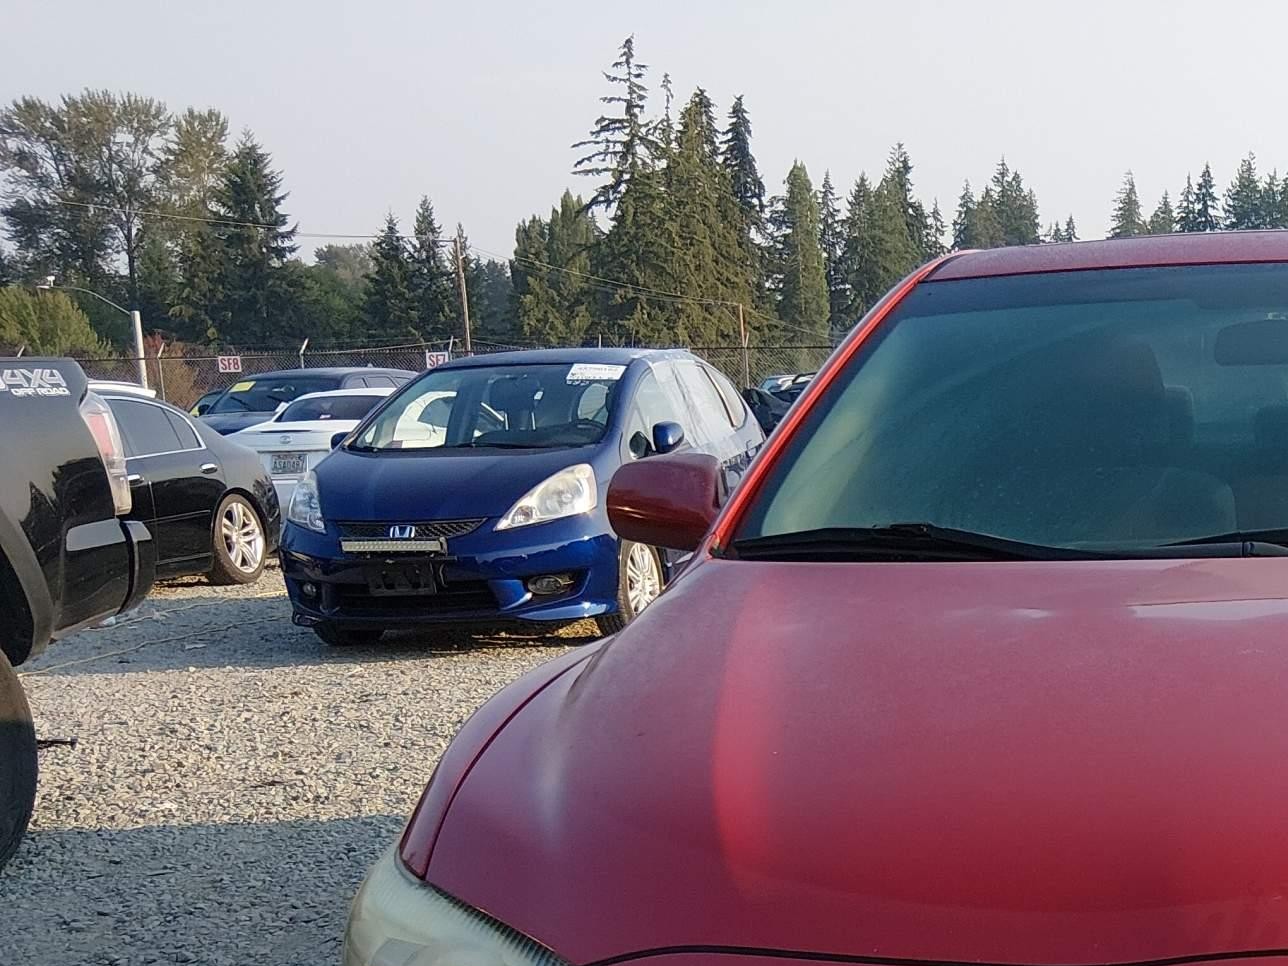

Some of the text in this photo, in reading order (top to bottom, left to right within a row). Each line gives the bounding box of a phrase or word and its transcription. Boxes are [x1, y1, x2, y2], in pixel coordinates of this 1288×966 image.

[220, 358, 241, 371] SF8
[10, 387, 71, 397] OFF ROAD
